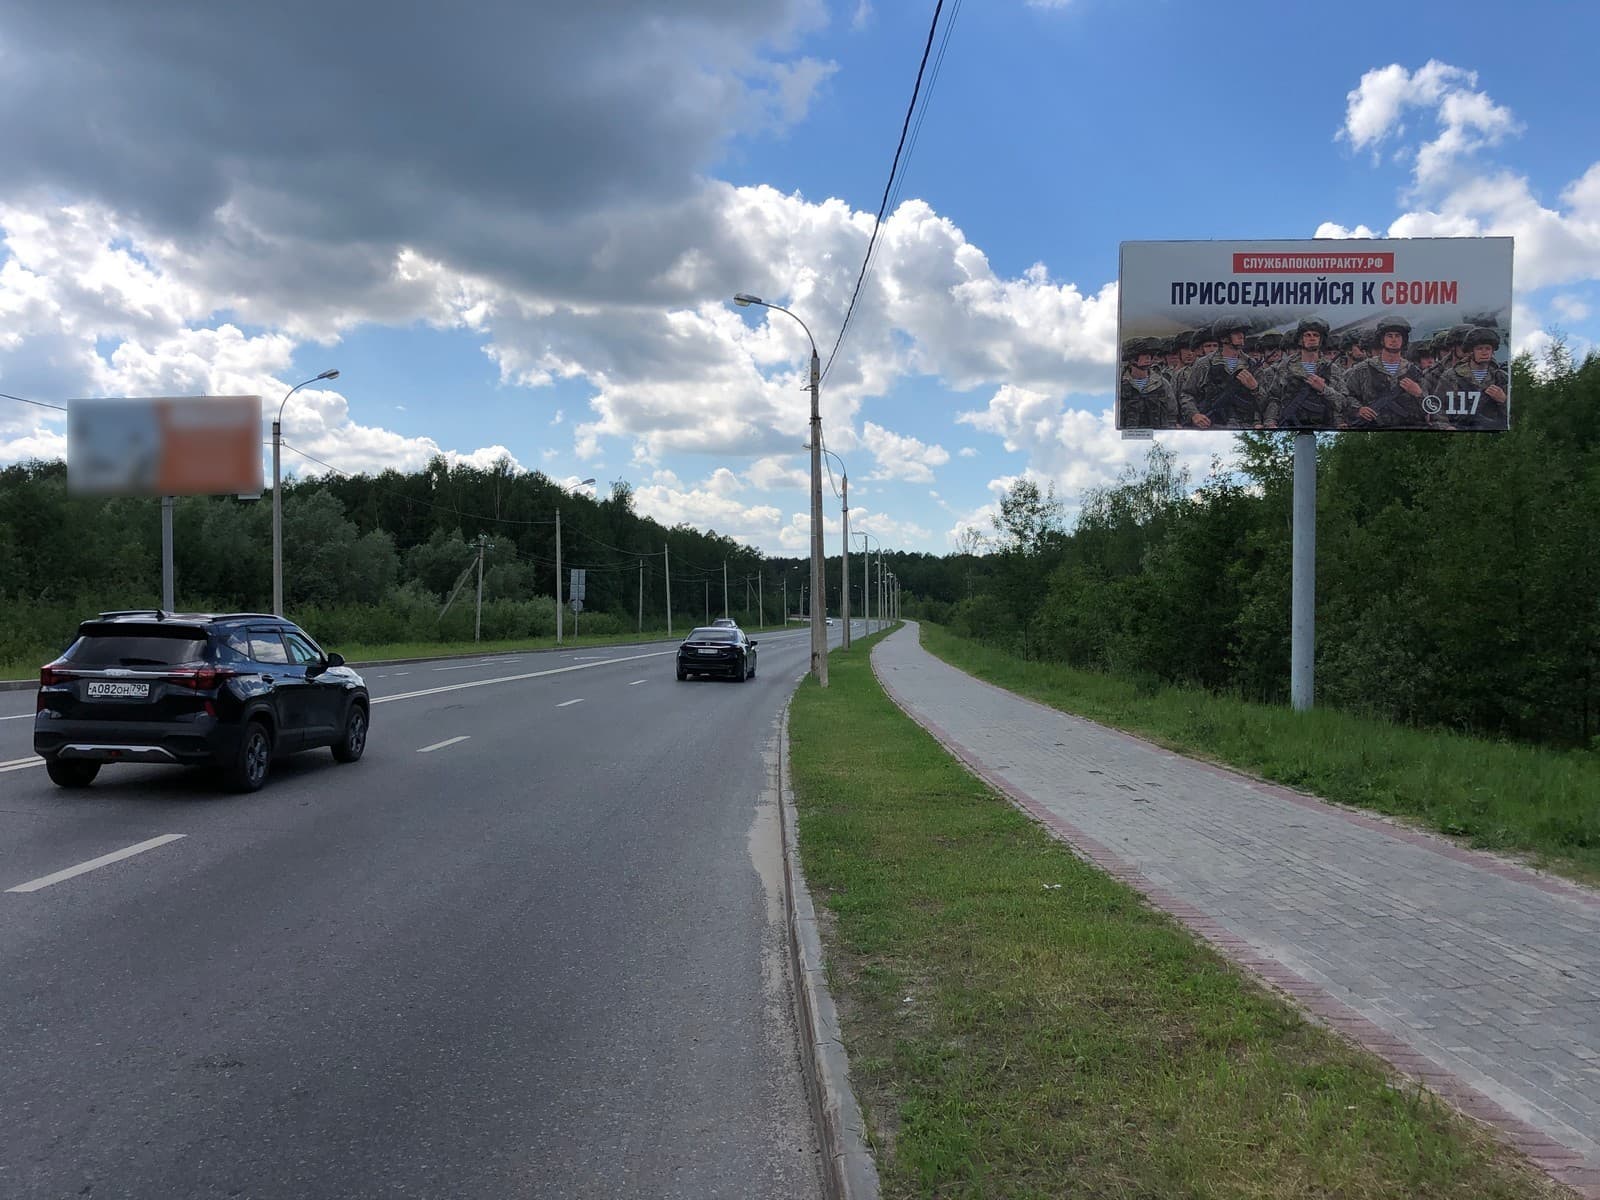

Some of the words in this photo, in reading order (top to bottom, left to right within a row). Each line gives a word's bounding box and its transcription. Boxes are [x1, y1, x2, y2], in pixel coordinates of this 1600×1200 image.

[1243, 257, 1383, 269] СЛУЖБАПОКОНТРАКТУ.РФ
[1171, 277, 1354, 307] ПРИСОЕДИНЯЙСЯ
[1362, 282, 1375, 304] К
[1381, 281, 1458, 304] СВОИМ
[1446, 391, 1481, 415] 117
